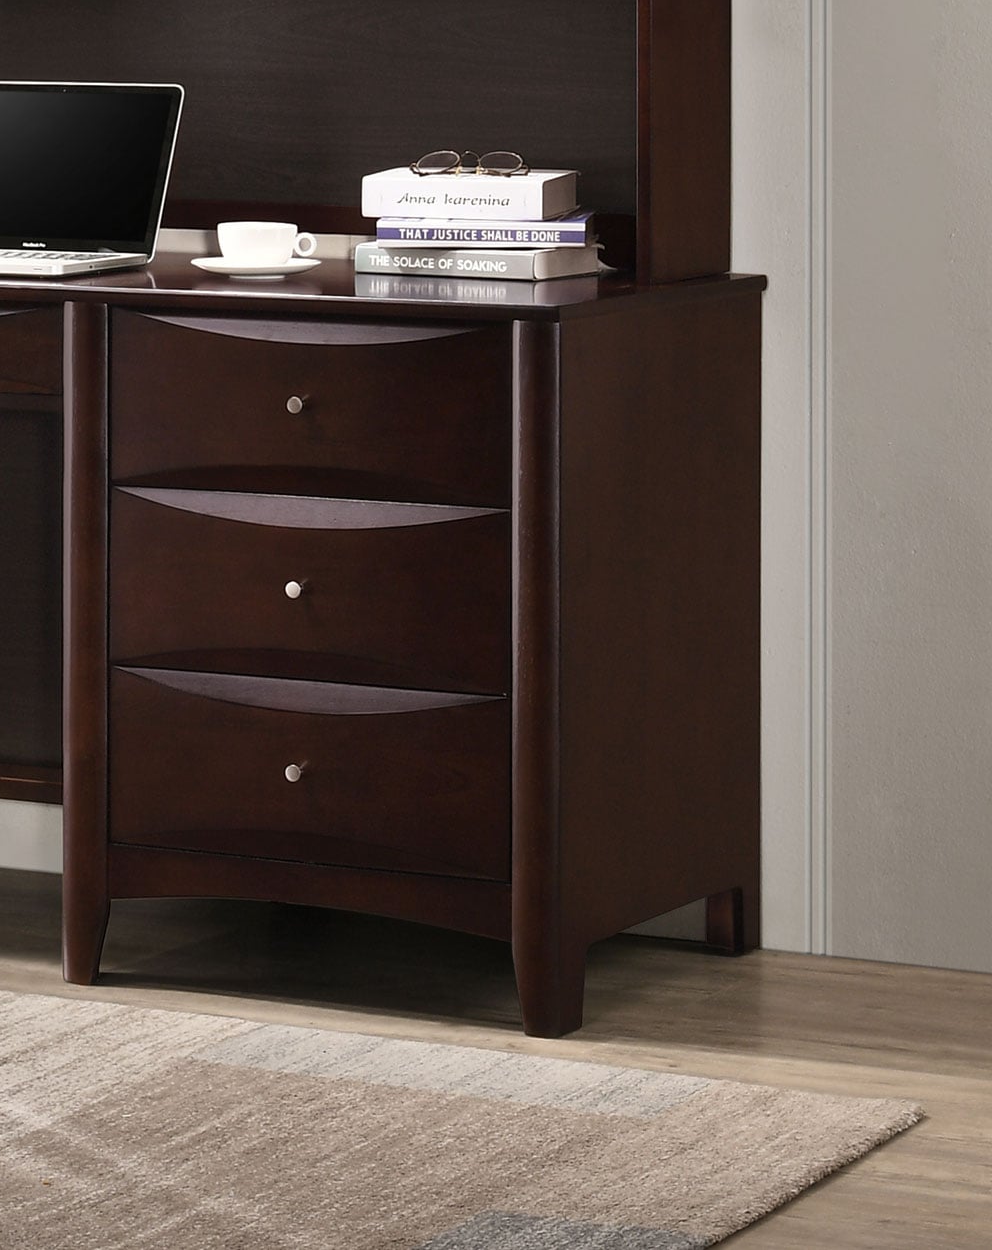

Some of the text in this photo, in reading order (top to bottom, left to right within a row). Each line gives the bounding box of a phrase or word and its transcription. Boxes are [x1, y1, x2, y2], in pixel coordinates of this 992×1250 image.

[397, 193, 436, 204] Anna
[399, 228, 560, 242] THAT JUSTICE SHALL BE DONE
[369, 255, 508, 272] THE SOLACE OF SOAKING
